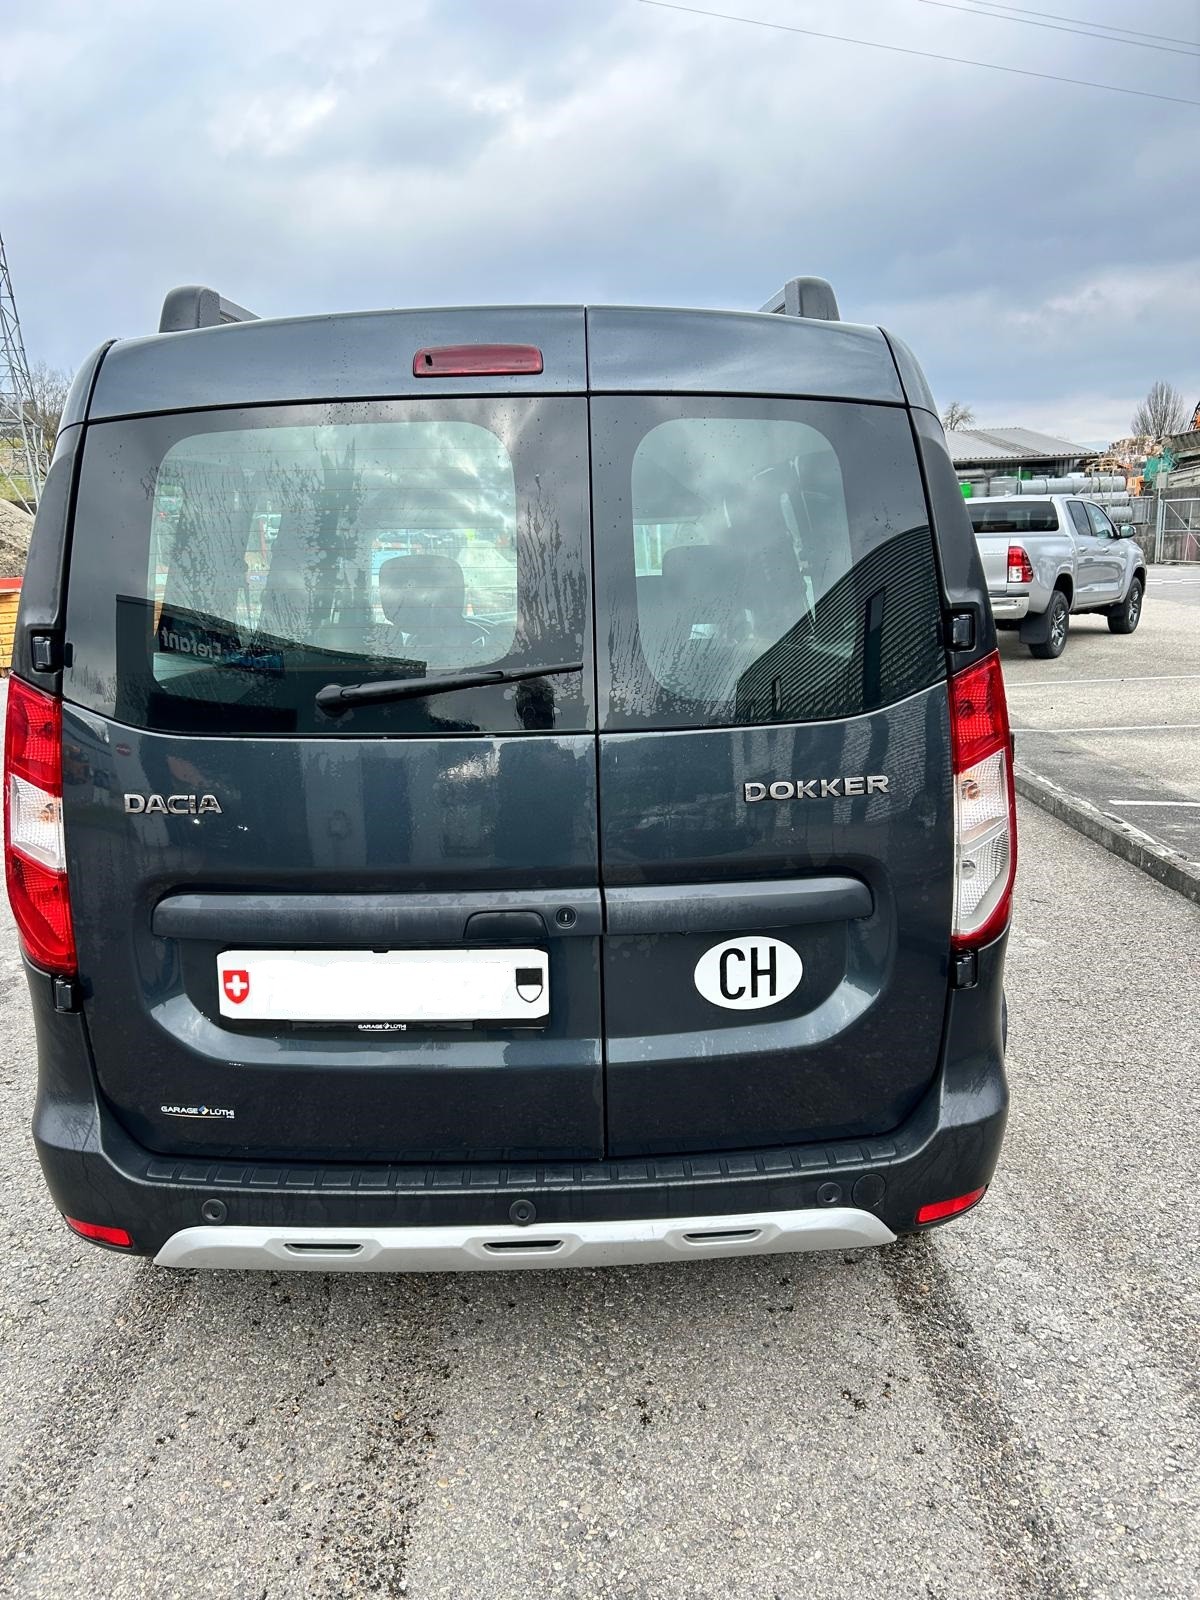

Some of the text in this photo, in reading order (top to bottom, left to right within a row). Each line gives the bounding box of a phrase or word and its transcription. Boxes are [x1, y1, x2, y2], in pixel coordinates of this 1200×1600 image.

[744, 775, 889, 802] DOKKER
[123, 793, 222, 814] DACIA
[719, 946, 777, 1000] CH
[160, 1105, 199, 1114] GARAGE
